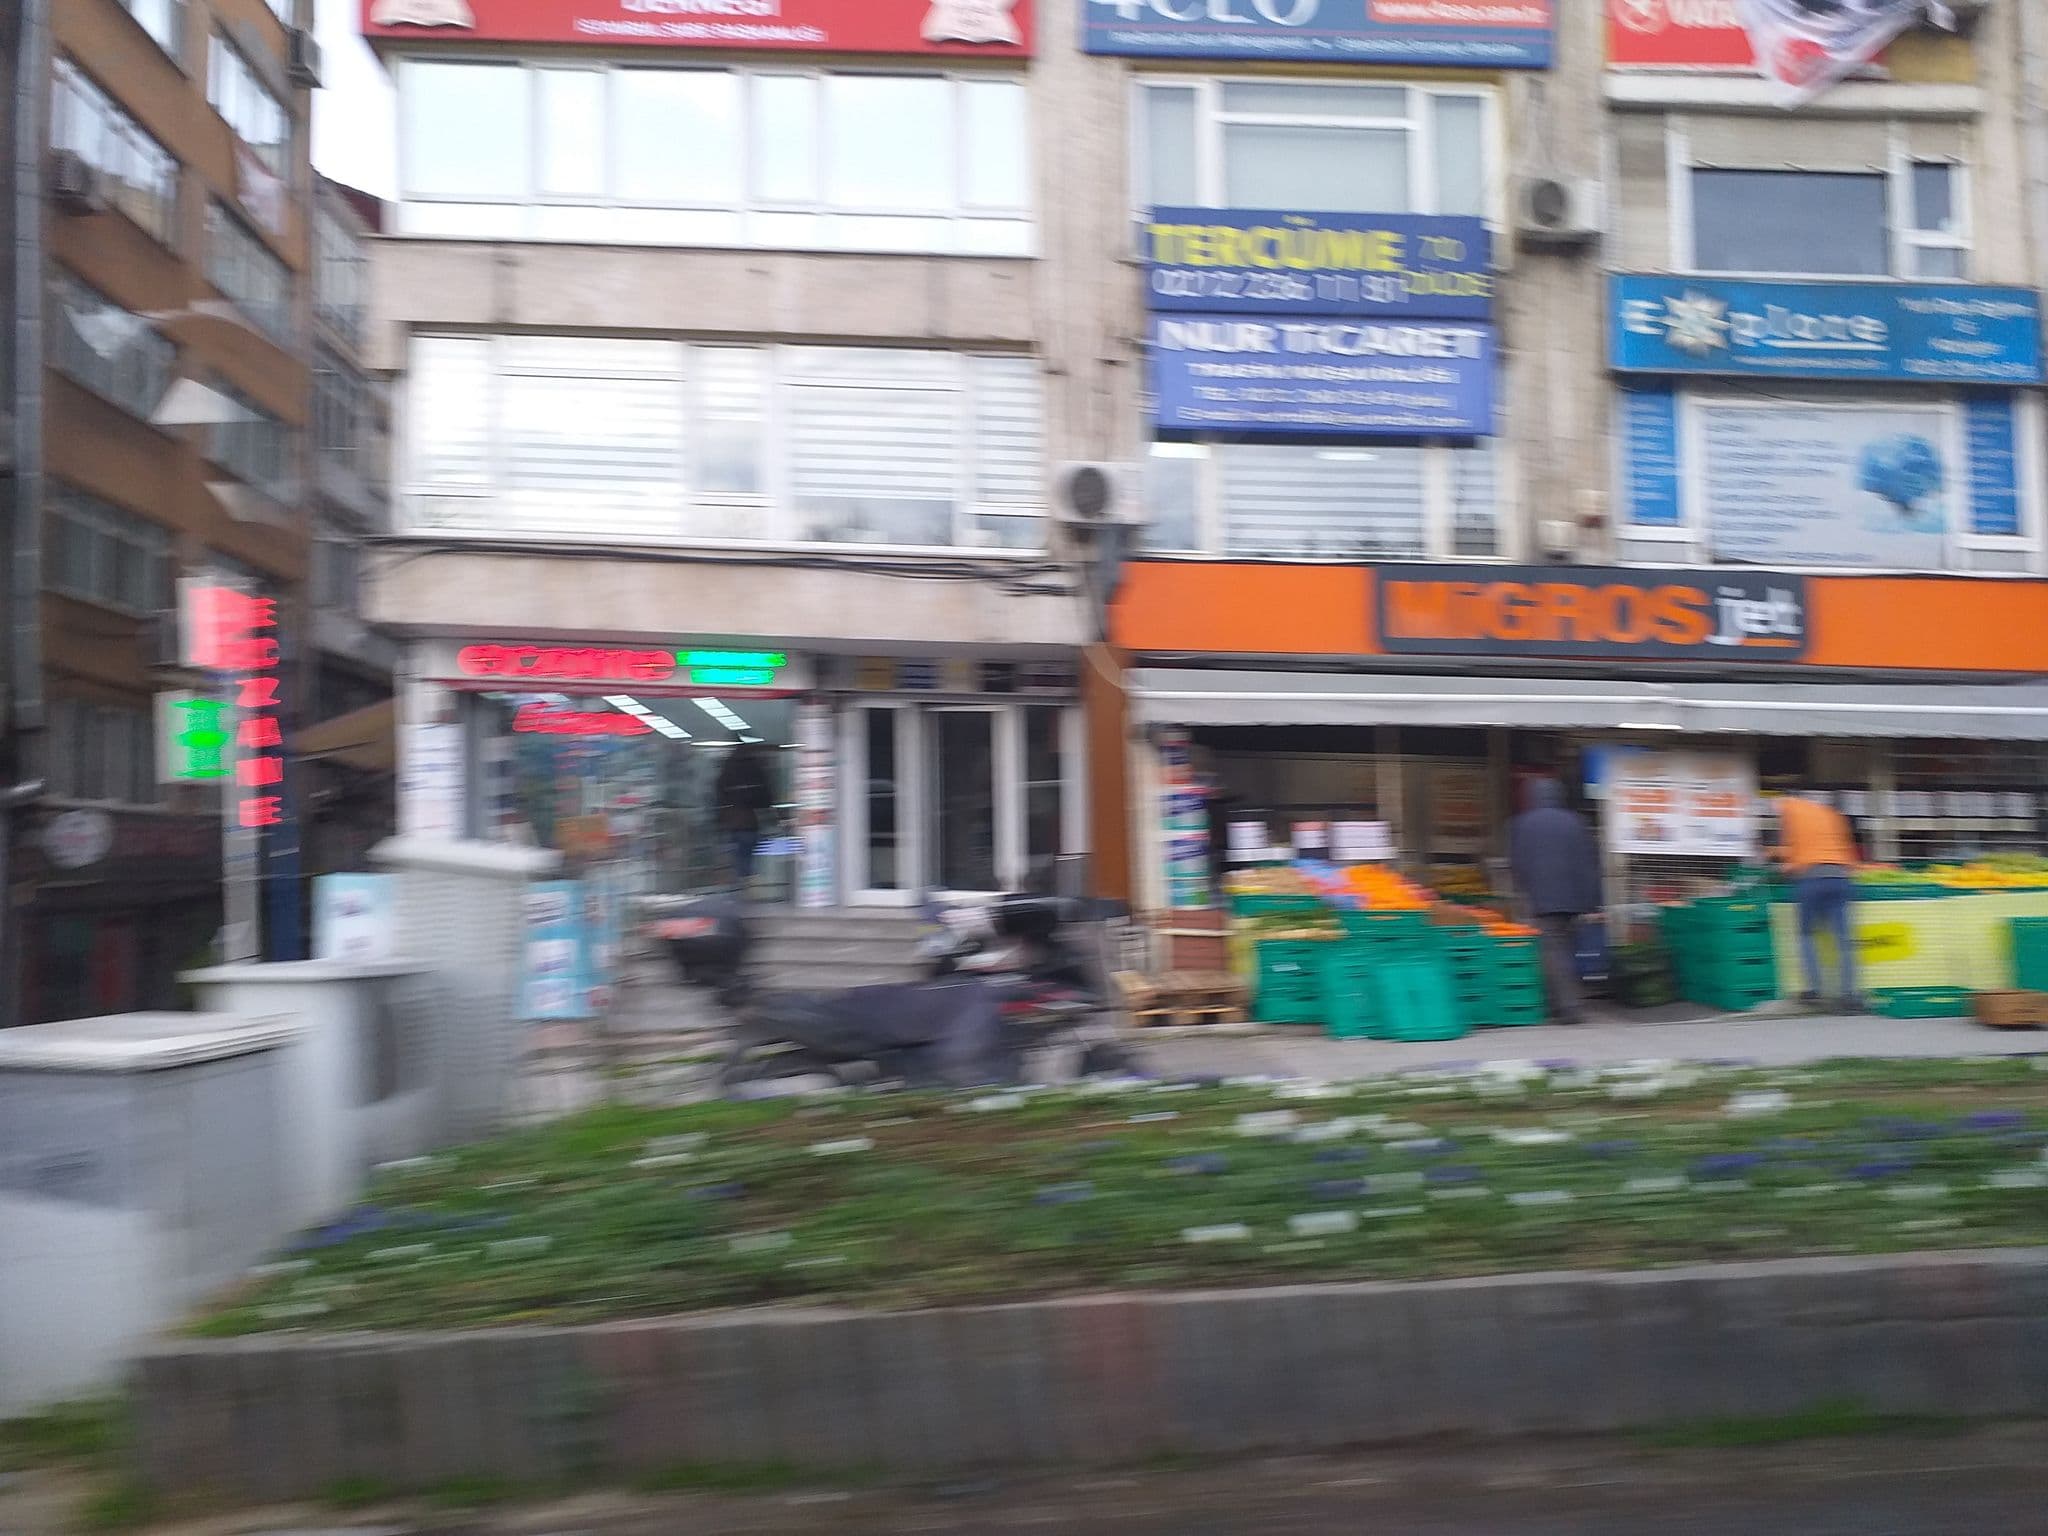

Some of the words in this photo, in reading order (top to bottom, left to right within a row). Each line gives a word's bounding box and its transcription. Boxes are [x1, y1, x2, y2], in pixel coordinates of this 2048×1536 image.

[1146, 214, 1407, 272] TERCÜME
[1157, 319, 1279, 354] NUR
[1706, 586, 1805, 648] jet
